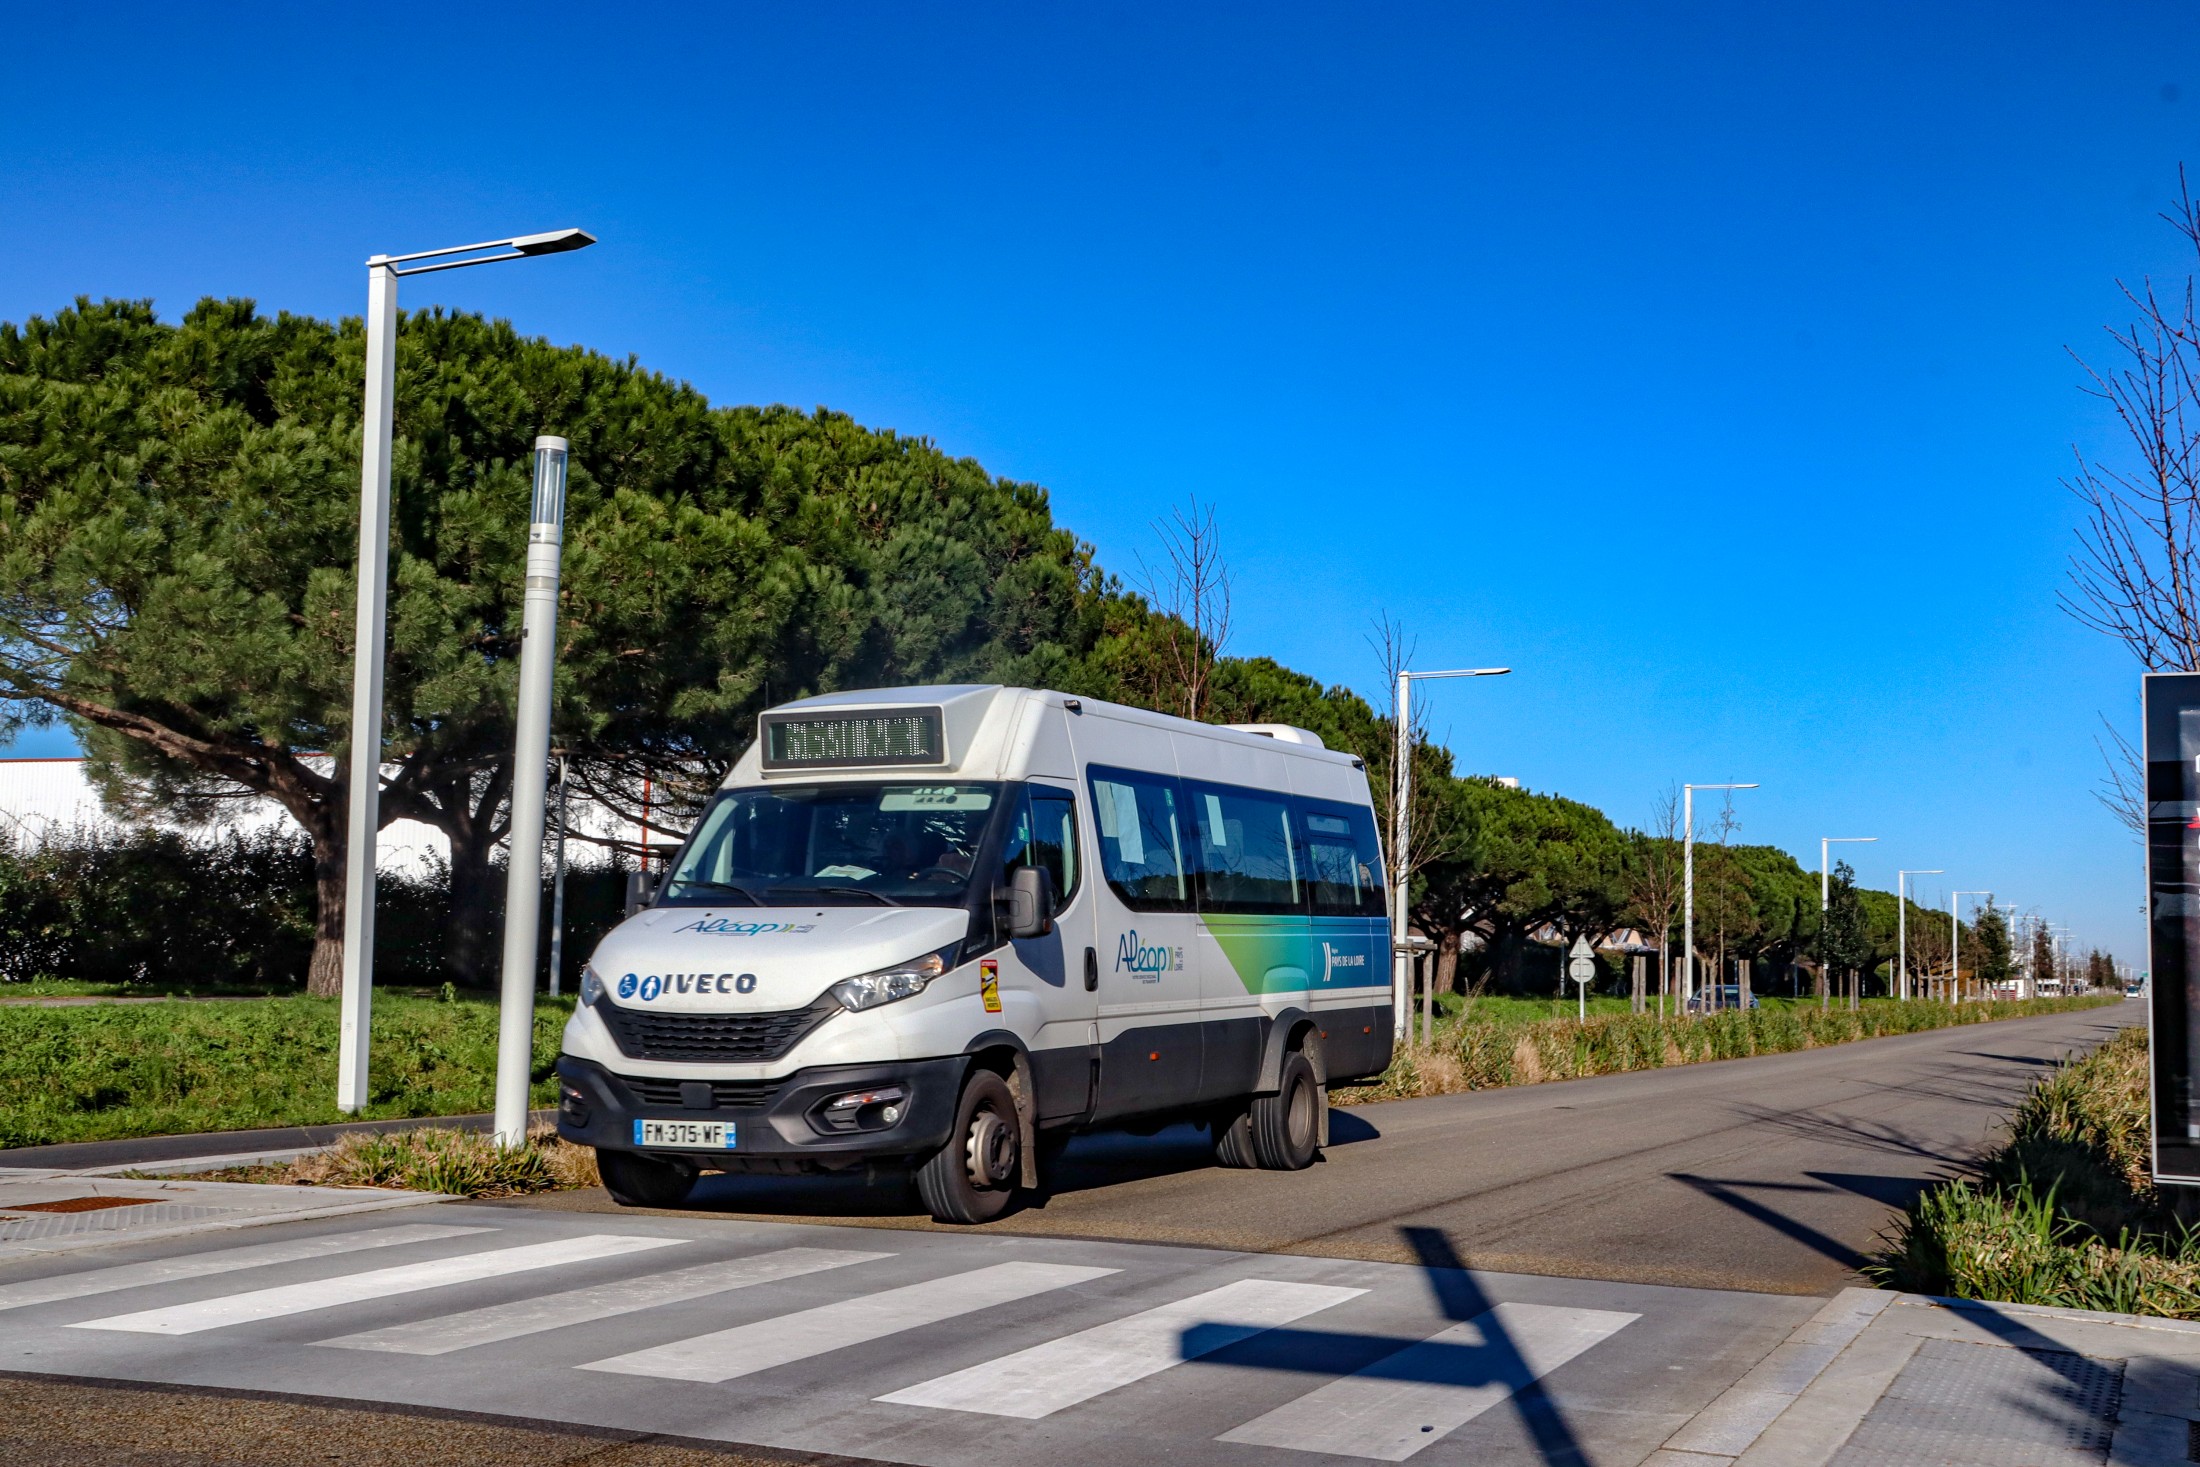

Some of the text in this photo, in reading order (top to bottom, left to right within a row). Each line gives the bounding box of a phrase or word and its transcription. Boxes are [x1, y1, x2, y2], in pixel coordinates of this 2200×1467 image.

[673, 918, 778, 936] Aléap
[1115, 929, 1166, 983] Aléap
[1331, 956, 1341, 967] PAYS
[1354, 955, 1364, 966] LOIRE
[662, 973, 757, 994] IVECO
[644, 1123, 722, 1143] FM-375-WF
